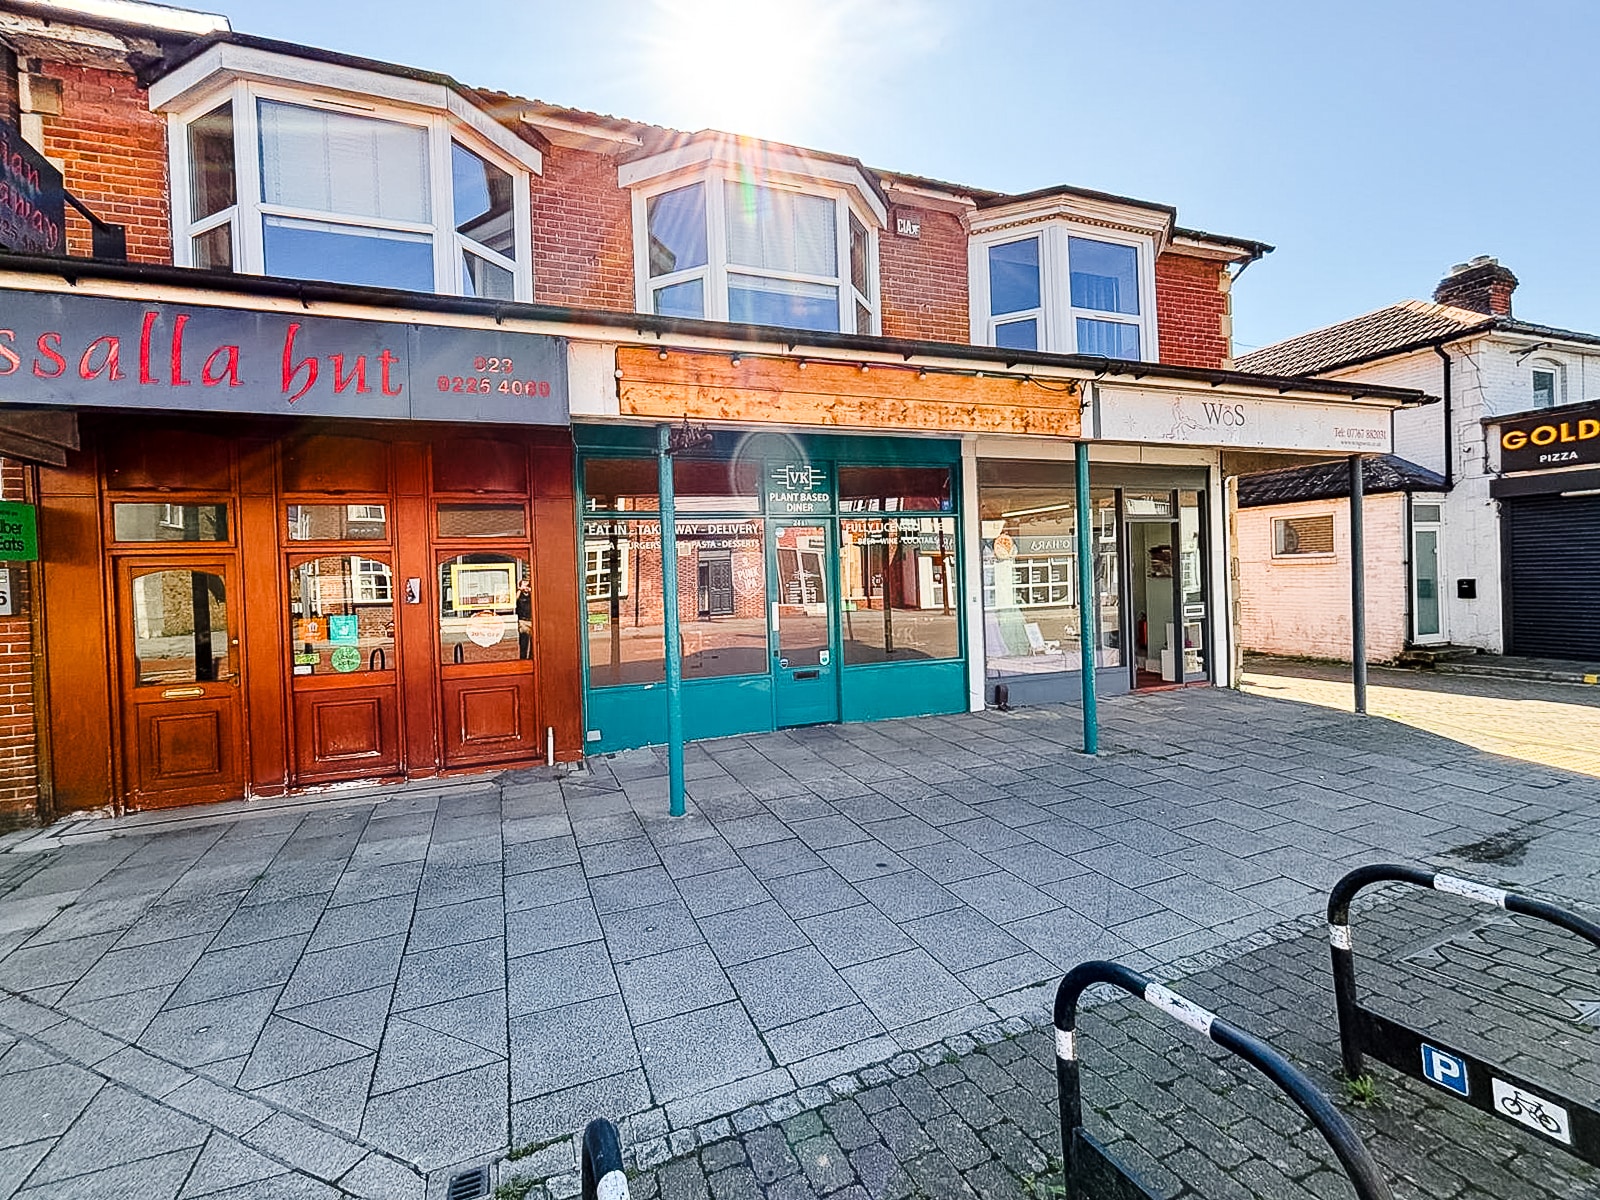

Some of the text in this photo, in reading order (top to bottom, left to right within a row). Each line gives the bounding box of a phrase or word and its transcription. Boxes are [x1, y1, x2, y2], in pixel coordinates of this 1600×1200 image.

[281, 323, 402, 404] hut
[1539, 450, 1579, 463] PIZZA
[789, 471, 809, 484] VK
[769, 492, 830, 502] PLANT BASED
[786, 503, 814, 512] DINER
[588, 524, 611, 536] EAT
[613, 524, 628, 536] IN
[707, 522, 760, 535] DELIVERY
[845, 522, 876, 533] FULLY
[691, 539, 716, 549] PASTA
[721, 539, 760, 549] DESSERTS
[1431, 1050, 1460, 1082] P
